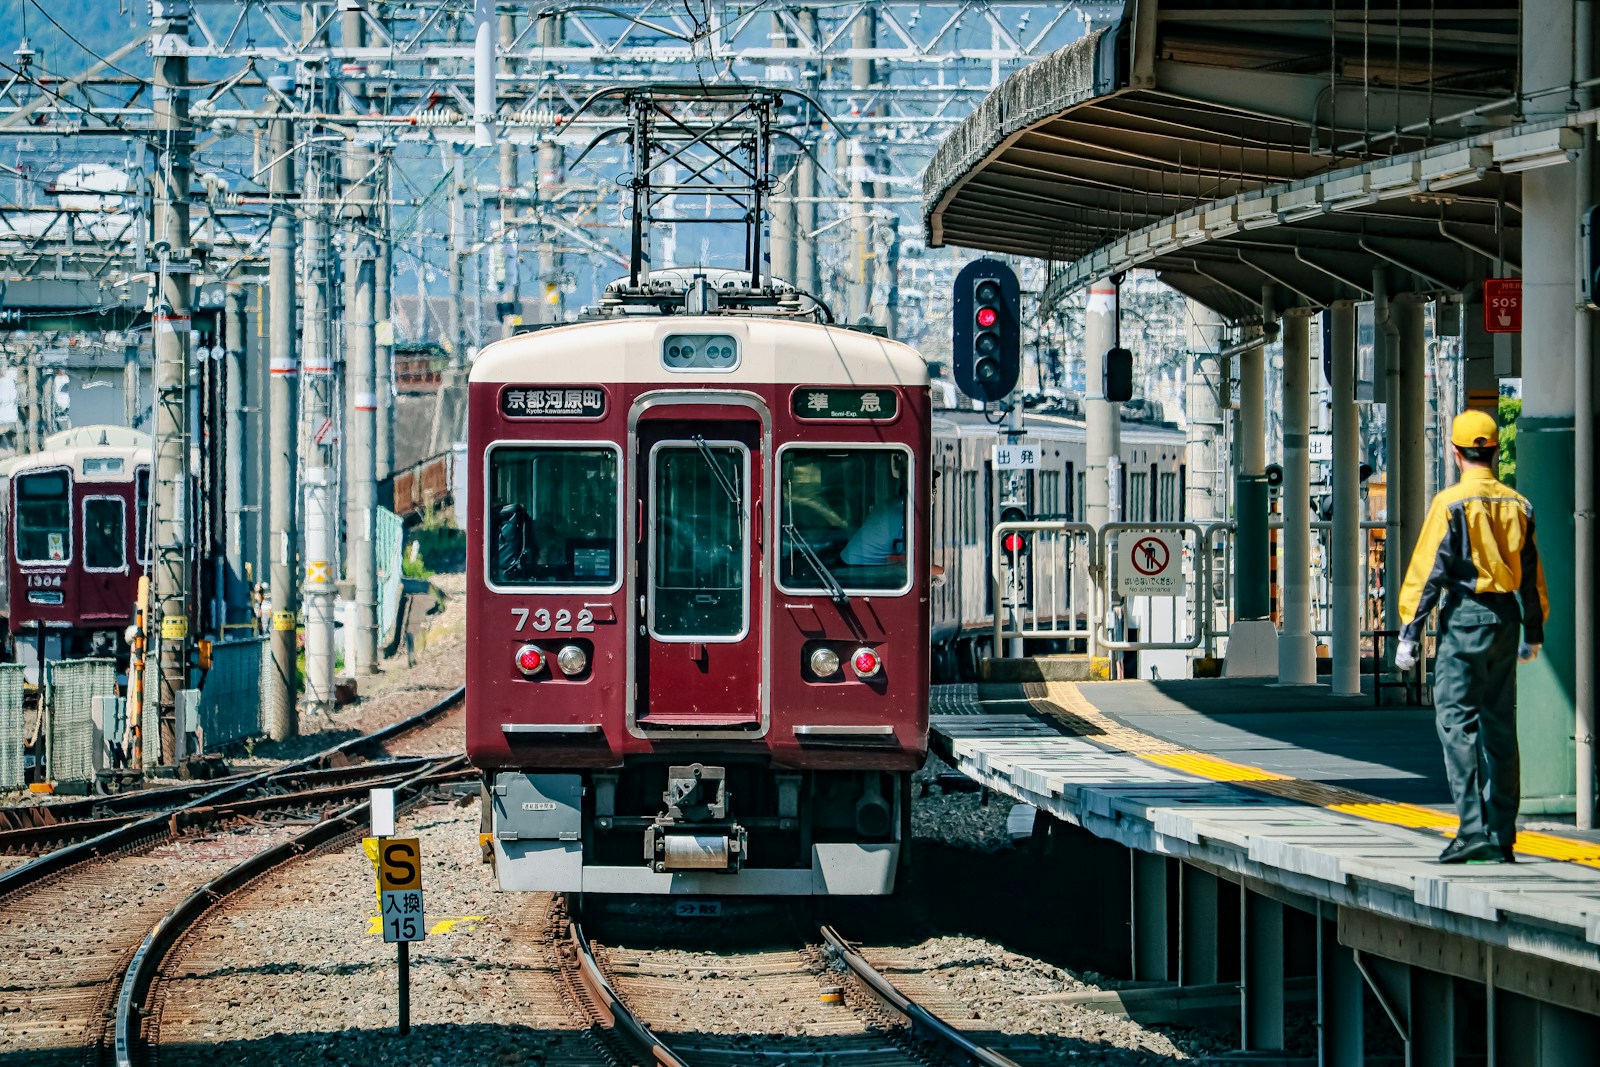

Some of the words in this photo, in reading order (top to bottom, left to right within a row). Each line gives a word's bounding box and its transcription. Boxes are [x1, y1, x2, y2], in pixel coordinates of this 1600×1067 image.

[1492, 298, 1517, 308] SOS
[507, 390, 602, 409] 京都河原町
[808, 393, 881, 412] 準急
[998, 450, 1033, 464] 出発
[1124, 577, 1176, 585] はいらないでください
[511, 608, 595, 632] 7322
[384, 843, 416, 885] S
[385, 893, 420, 914] 入換
[390, 917, 417, 939] 15
